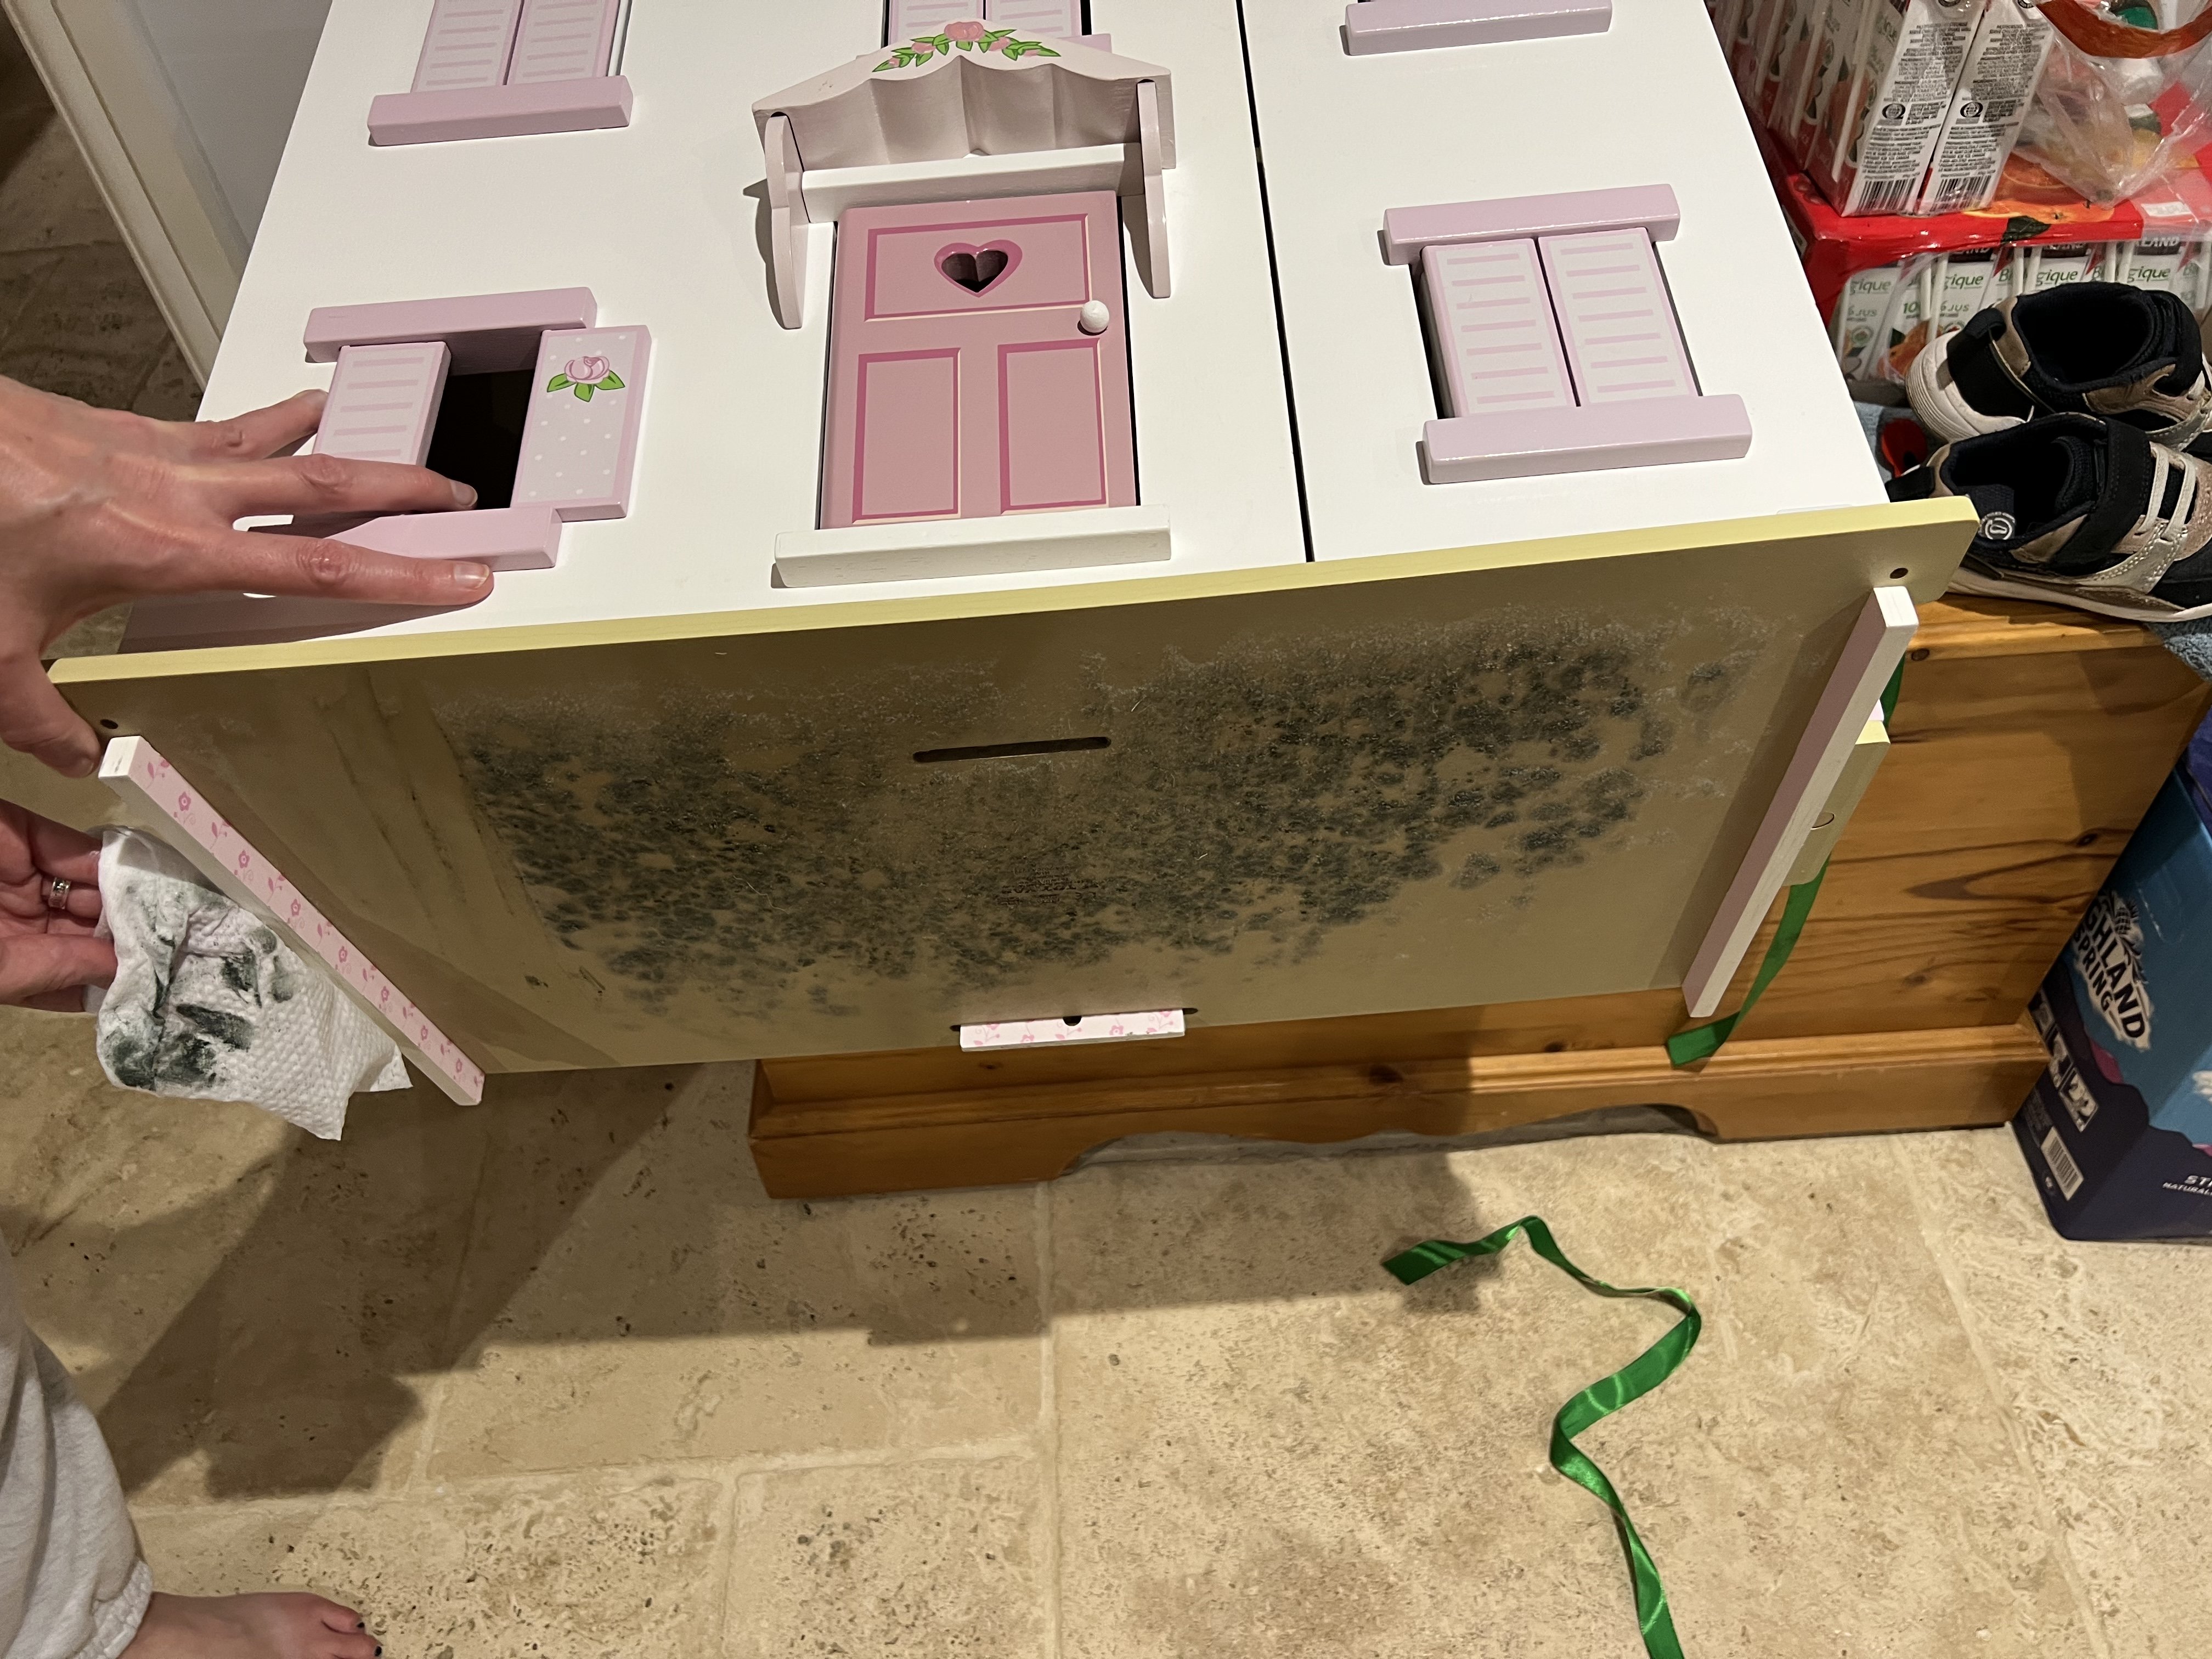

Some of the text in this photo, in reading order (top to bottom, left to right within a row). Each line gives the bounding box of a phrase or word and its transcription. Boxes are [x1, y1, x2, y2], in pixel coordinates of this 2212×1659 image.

[2141, 236, 2180, 246] LAND
[2085, 898, 2145, 1038] GHLAND
[2163, 1182, 2212, 1196] NATURAL
